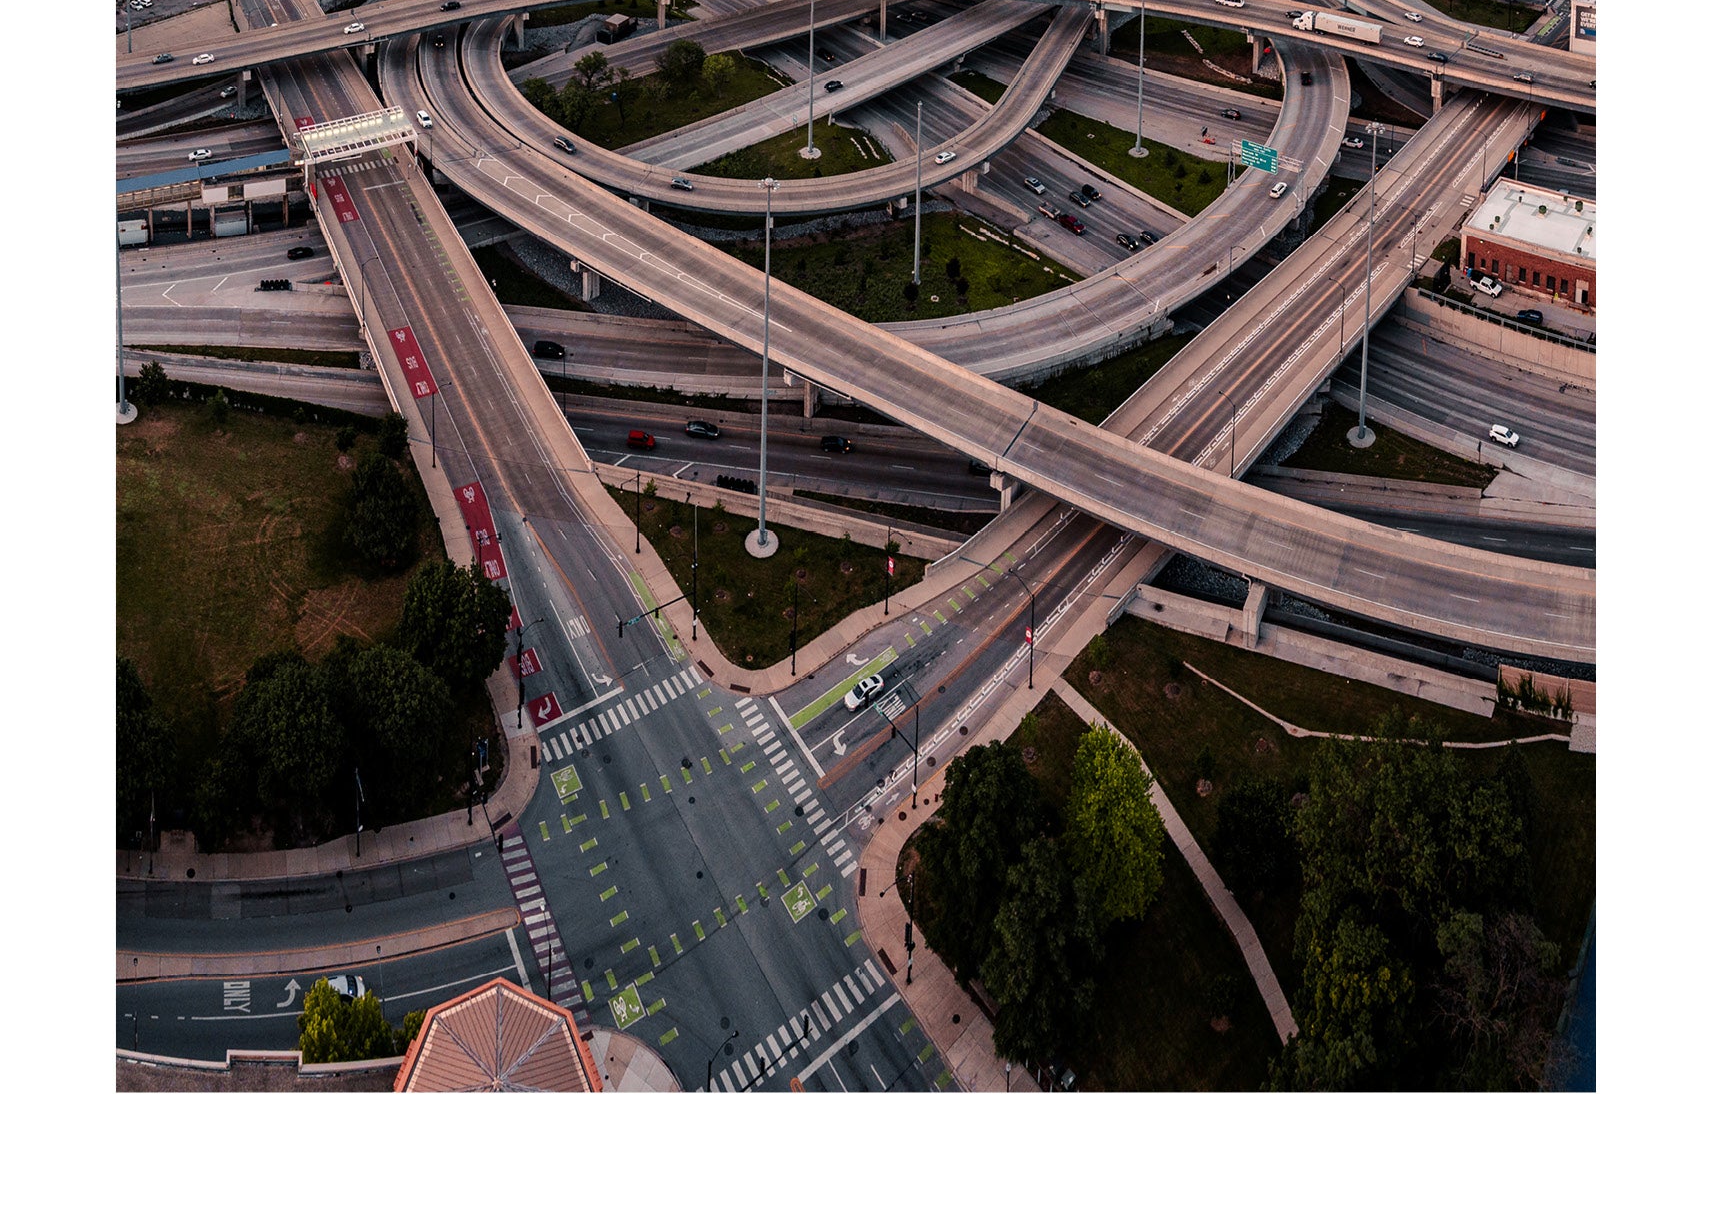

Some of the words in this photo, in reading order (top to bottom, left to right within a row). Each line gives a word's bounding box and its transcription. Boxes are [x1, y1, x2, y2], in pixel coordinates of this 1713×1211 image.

[566, 614, 591, 640] ONLY
[877, 692, 906, 721] ONLY
[223, 981, 251, 1013] ONLY
